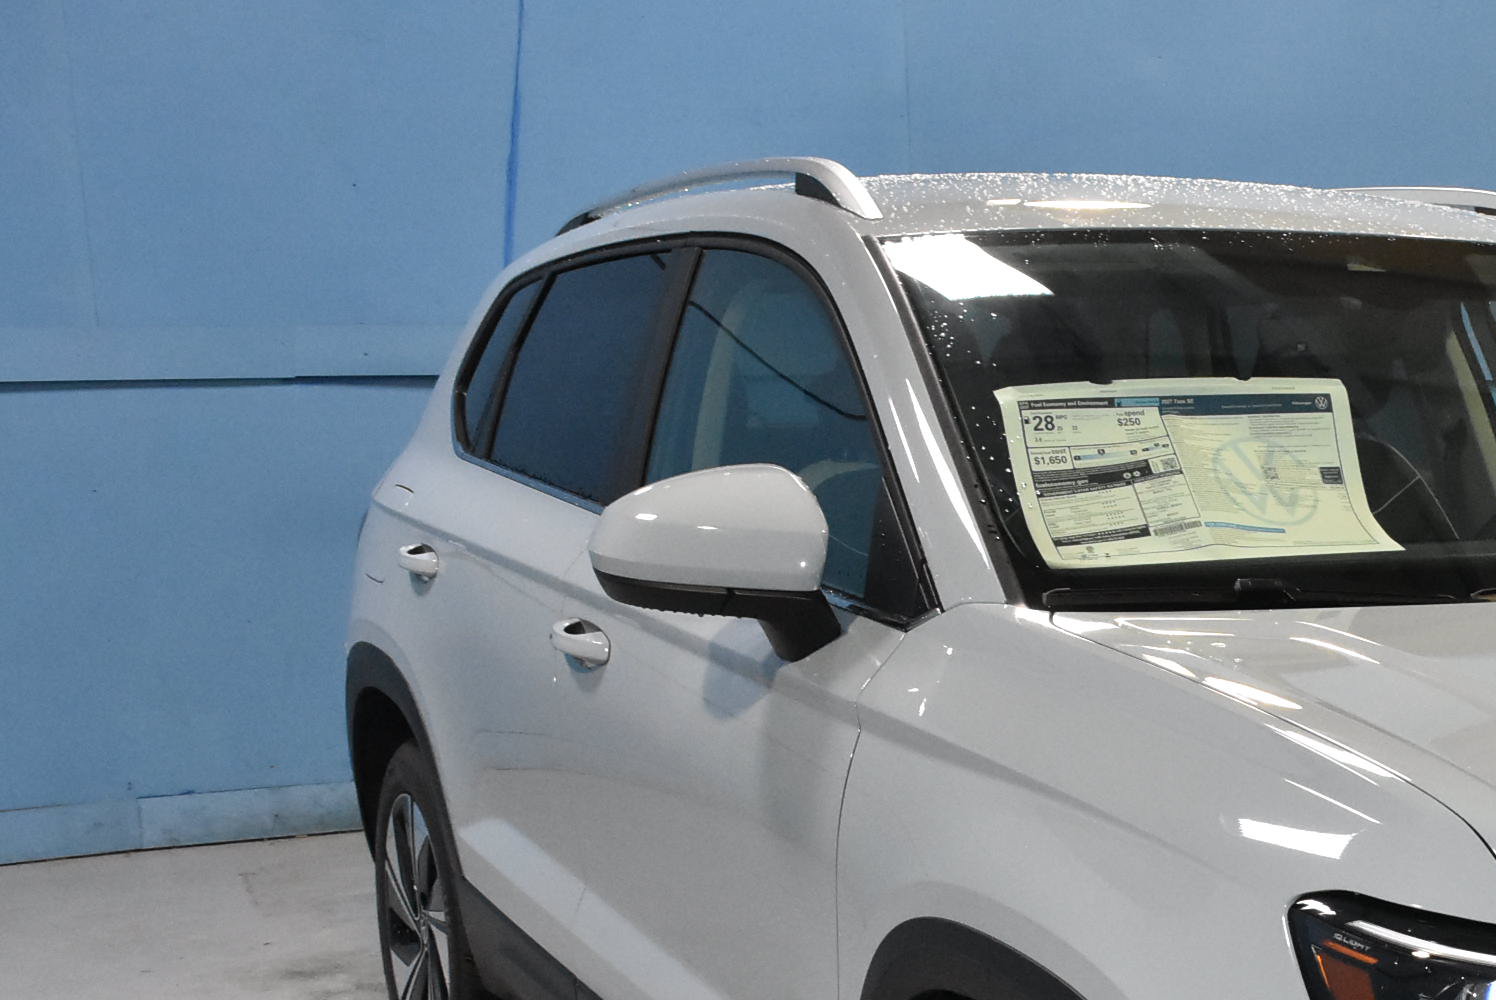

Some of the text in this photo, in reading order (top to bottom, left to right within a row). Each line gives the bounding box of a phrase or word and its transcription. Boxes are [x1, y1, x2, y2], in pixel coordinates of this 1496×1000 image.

[1032, 414, 1056, 432] 28
[1117, 417, 1141, 427] $250
[1034, 455, 1068, 466] $1,650
